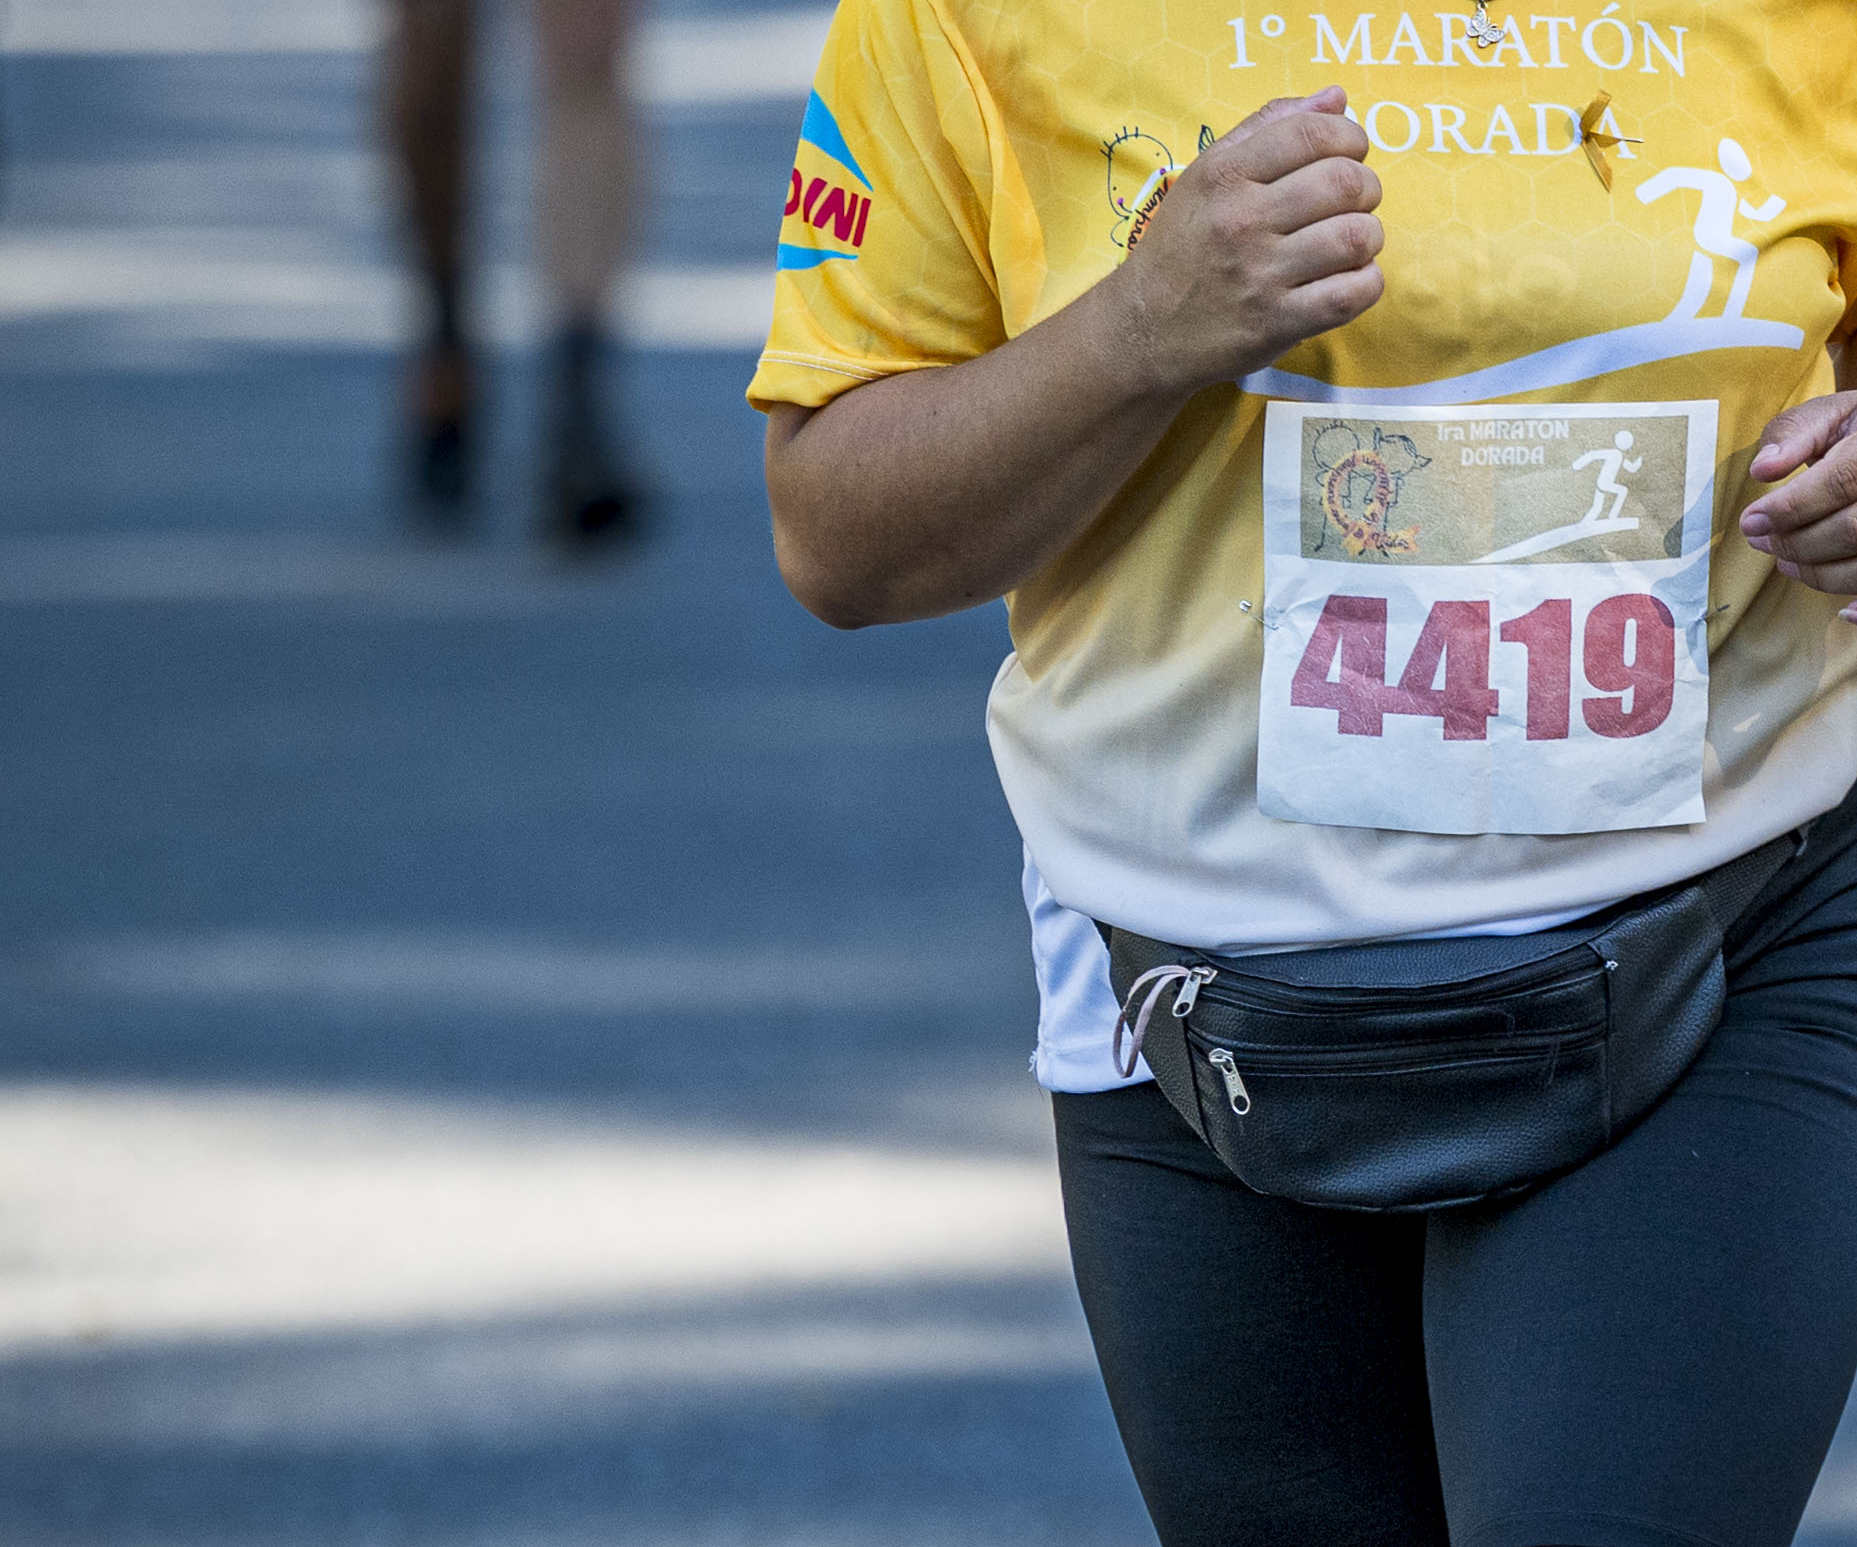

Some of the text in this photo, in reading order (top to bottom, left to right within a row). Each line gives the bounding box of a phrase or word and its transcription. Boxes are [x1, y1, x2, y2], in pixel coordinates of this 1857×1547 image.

[1309, 2, 1689, 78] MARATÓN
[1345, 99, 1638, 159] ORADA
[1461, 445, 1545, 466] DORADA
[1290, 593, 1676, 741] 4419
